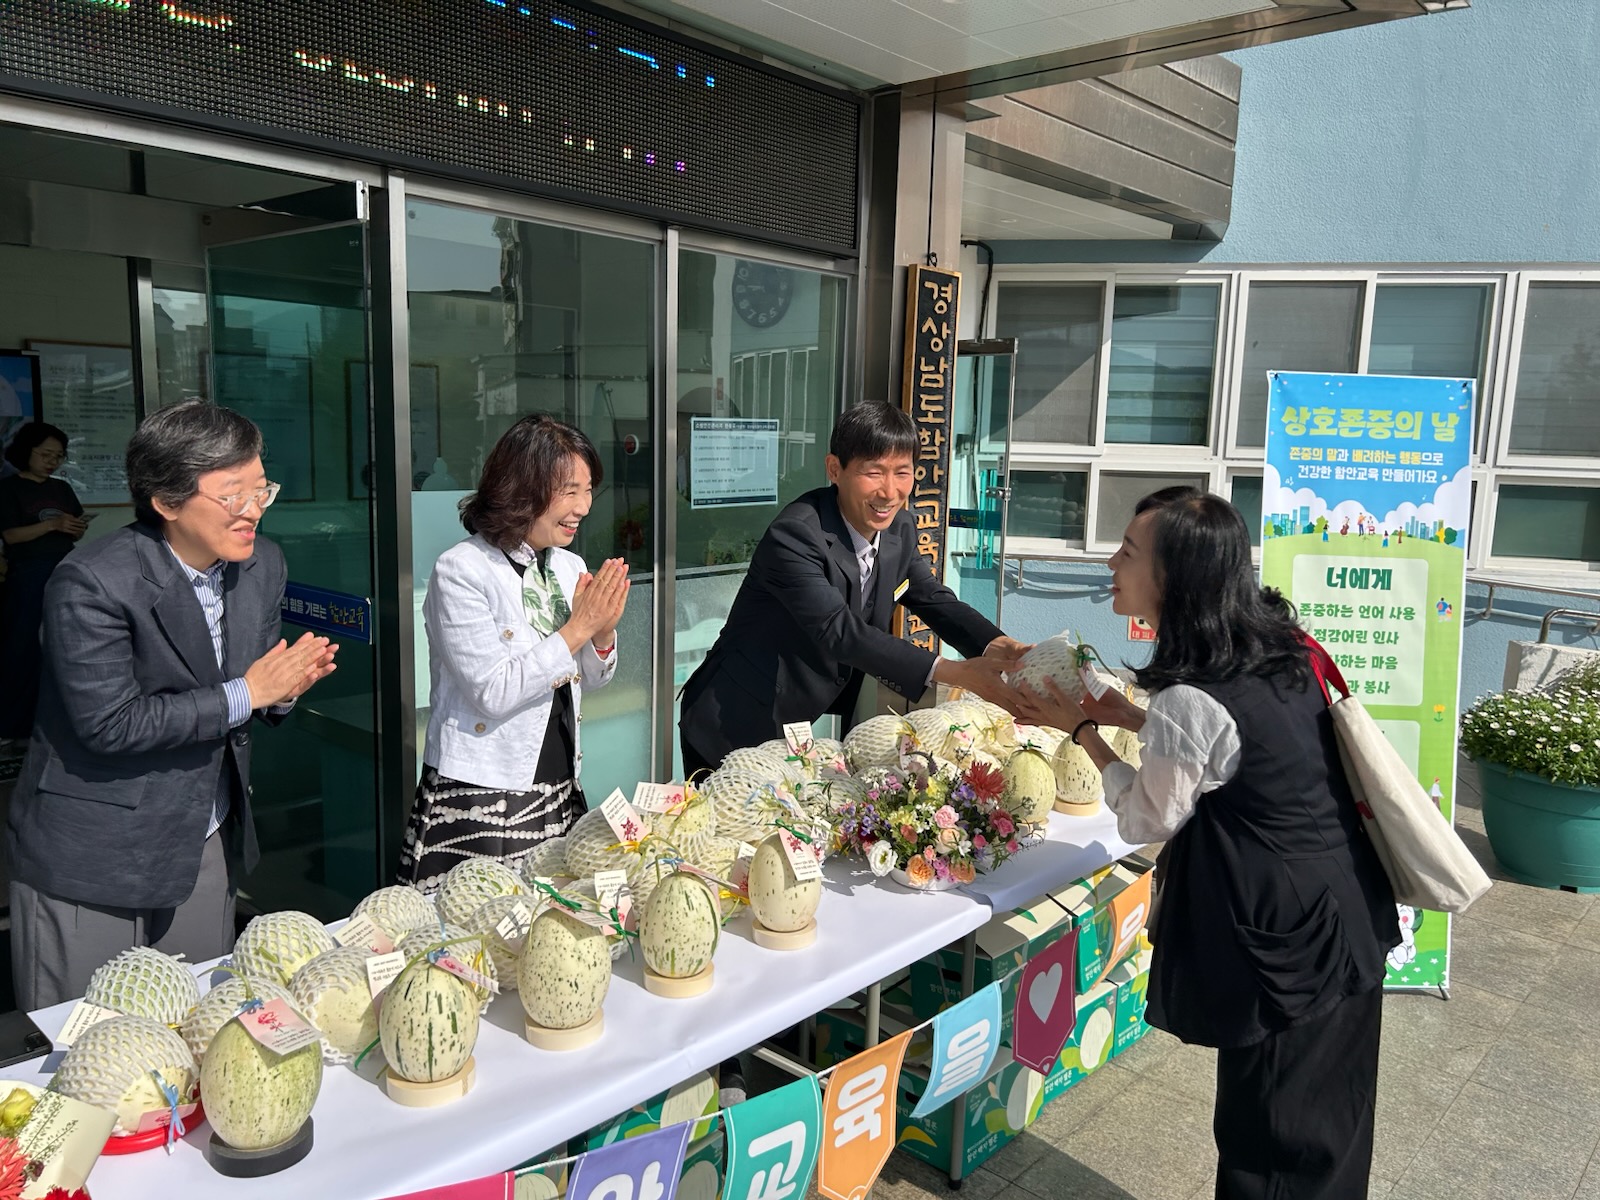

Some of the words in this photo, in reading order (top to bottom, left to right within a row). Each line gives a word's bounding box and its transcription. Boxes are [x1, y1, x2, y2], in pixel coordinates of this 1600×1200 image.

[747, 308, 757, 319] 7
[758, 312, 767, 323] 6
[1281, 406, 1424, 441] 상호존중의
[1431, 412, 1460, 443] 날
[1289, 446, 1323, 461] 존중의
[1326, 448, 1350, 463] 말과
[1352, 449, 1396, 465] 배려하는
[1399, 451, 1444, 467] 행동으로
[1298, 465, 1332, 480] 건강한
[1334, 466, 1379, 482] 함안교육
[1382, 468, 1438, 484] 만들어가요
[1326, 567, 1393, 591] 너에게
[289, 598, 304, 615] 힘을
[305, 601, 327, 620] 기르는
[329, 601, 364, 632] 함안교육
[1299, 602, 1354, 618] 존중하는
[1358, 605, 1385, 619] 언어
[1389, 606, 1416, 621] 사용
[1313, 628, 1368, 645] 정감어린
[1373, 630, 1400, 645] 인사
[1371, 655, 1399, 670] 마음
[1363, 680, 1391, 695] 봉사
